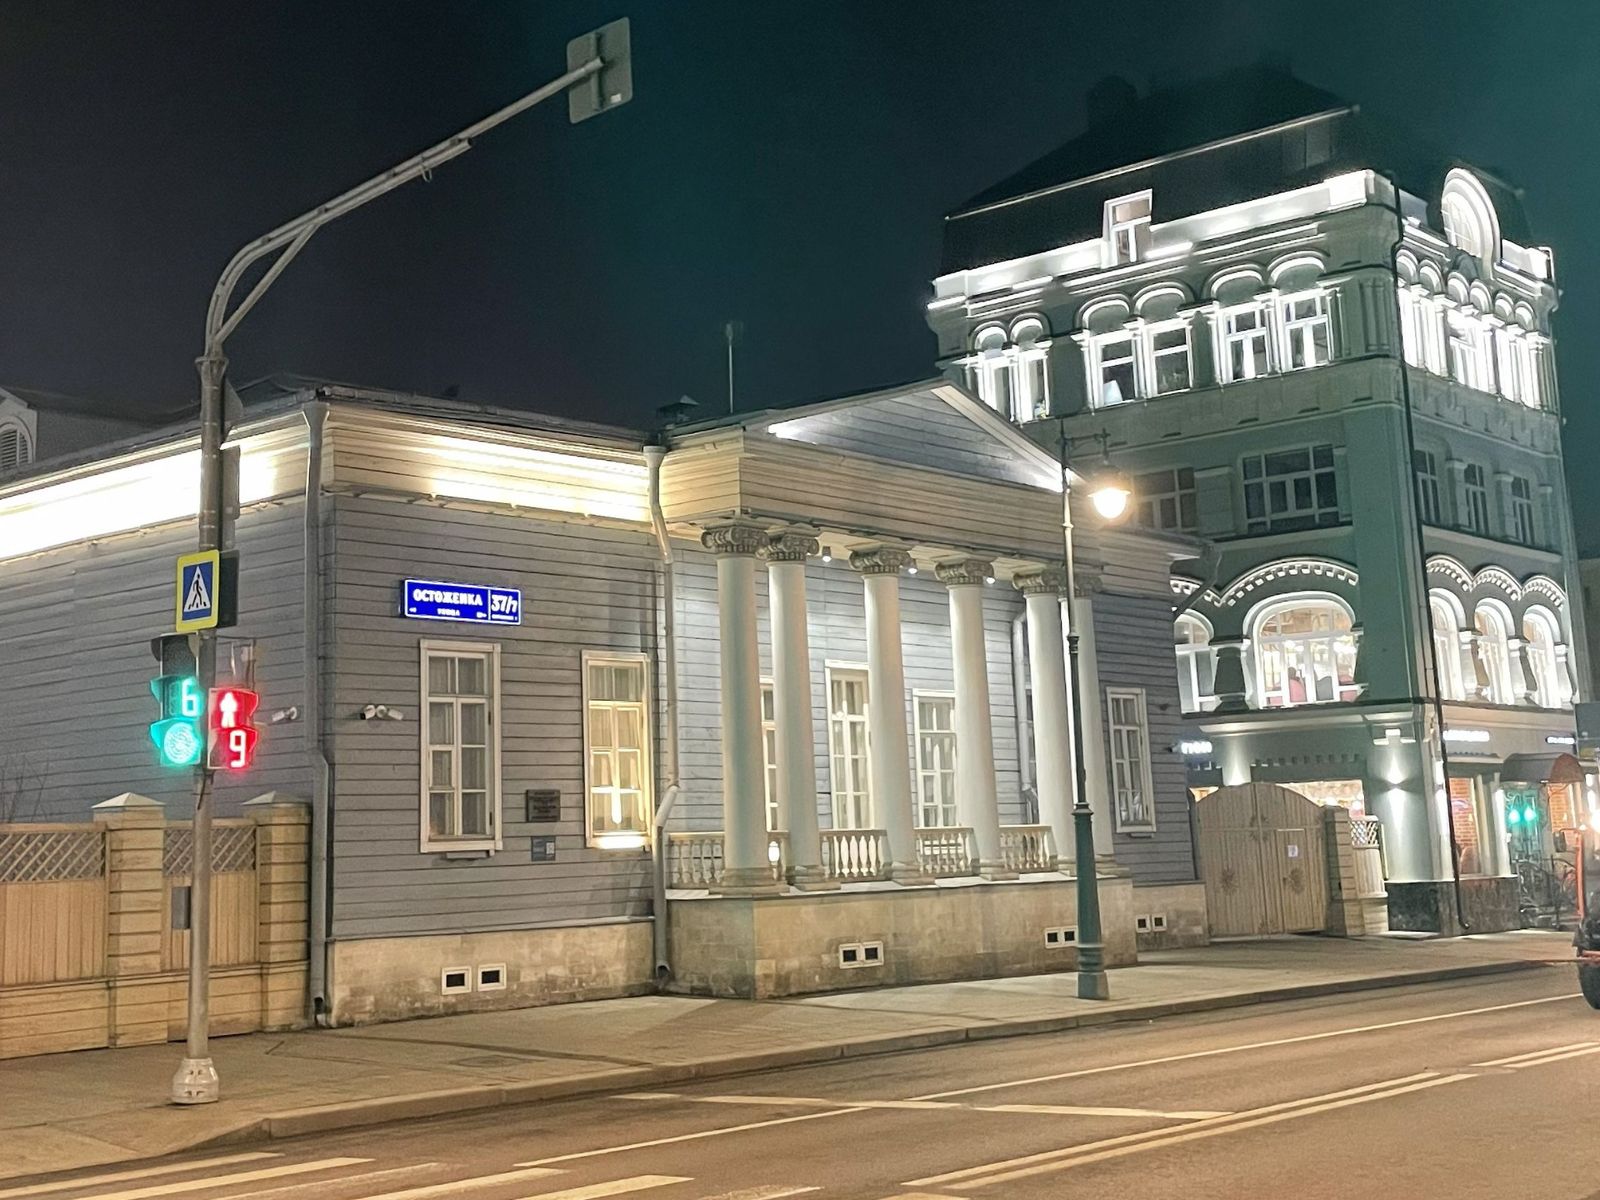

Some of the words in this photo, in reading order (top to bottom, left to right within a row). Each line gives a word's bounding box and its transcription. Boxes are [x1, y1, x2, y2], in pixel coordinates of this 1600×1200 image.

[413, 589, 483, 606] ОСТОЖЕНКА
[181, 678, 199, 717] 6
[229, 730, 247, 768] 9
